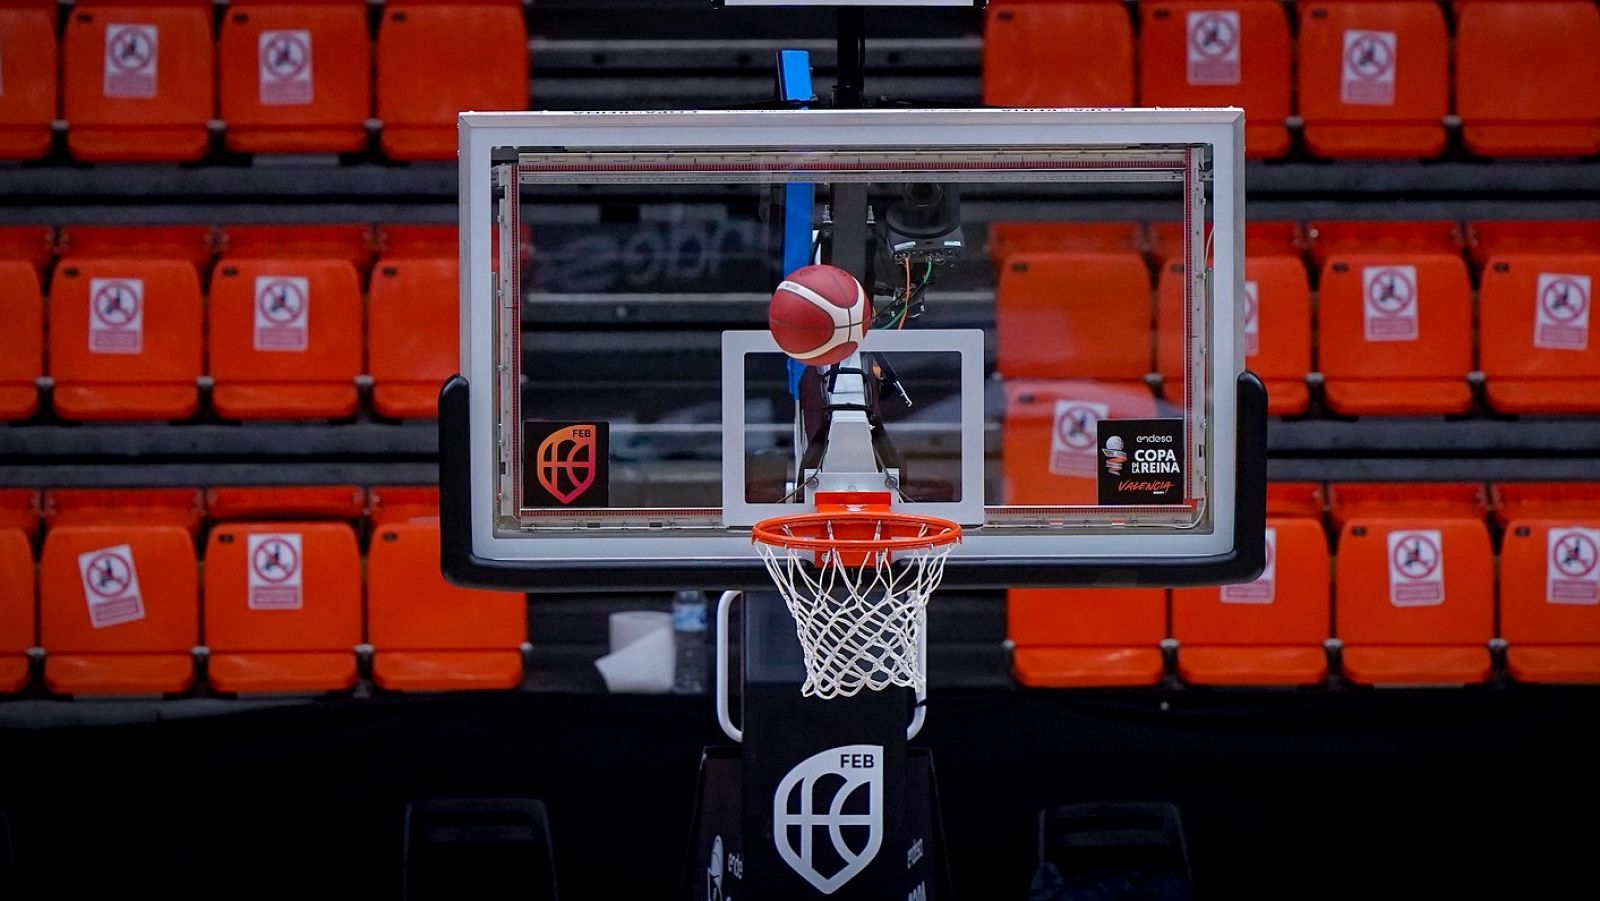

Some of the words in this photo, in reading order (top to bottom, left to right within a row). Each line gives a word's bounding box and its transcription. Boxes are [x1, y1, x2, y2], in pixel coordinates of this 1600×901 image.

[572, 429, 592, 438] FEB
[1136, 434, 1173, 443] endesa
[1134, 449, 1177, 462] COPA
[1141, 462, 1180, 474] REINA
[1118, 480, 1175, 493] VALENCIA
[840, 754, 875, 769] FEB
[727, 852, 743, 880] ende
